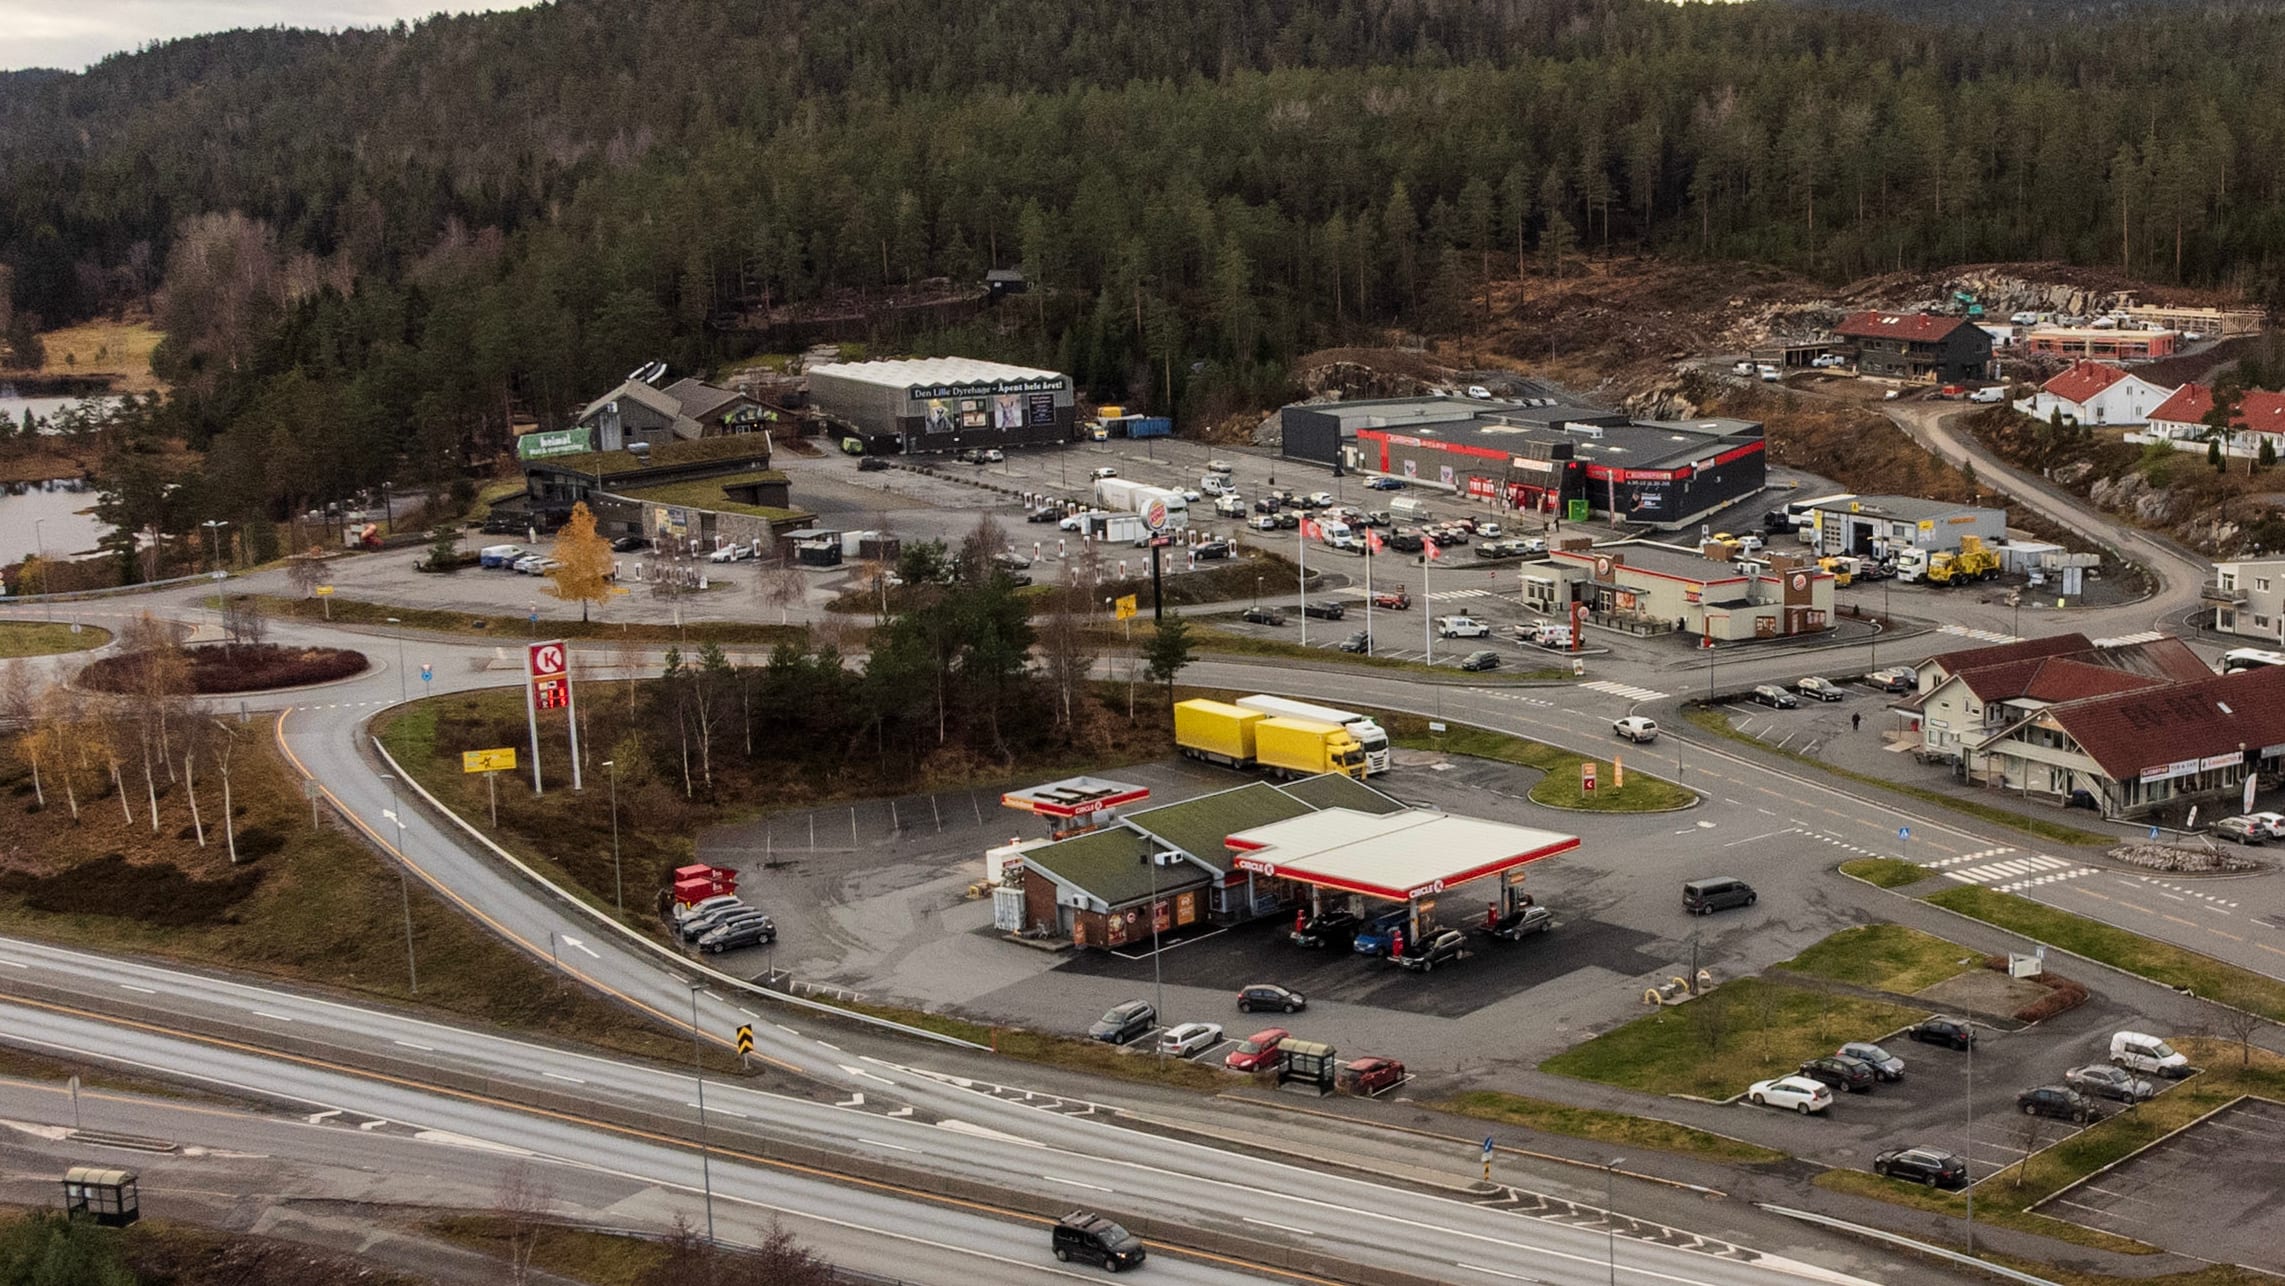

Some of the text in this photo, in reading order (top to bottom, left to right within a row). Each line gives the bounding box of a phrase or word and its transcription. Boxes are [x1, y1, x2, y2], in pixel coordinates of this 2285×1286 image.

[914, 388, 932, 398] Den
[933, 387, 951, 397] Lille
[952, 385, 991, 398] Dyrehage
[998, 381, 1023, 394] Åpent
[1024, 380, 1041, 391] hele
[1042, 379, 1063, 391] året!
[541, 648, 561, 670] K
[1075, 804, 1094, 815] CIRCLE
[1239, 860, 1264, 873] CIRCLE
[1408, 884, 1434, 898] CIRCLE
